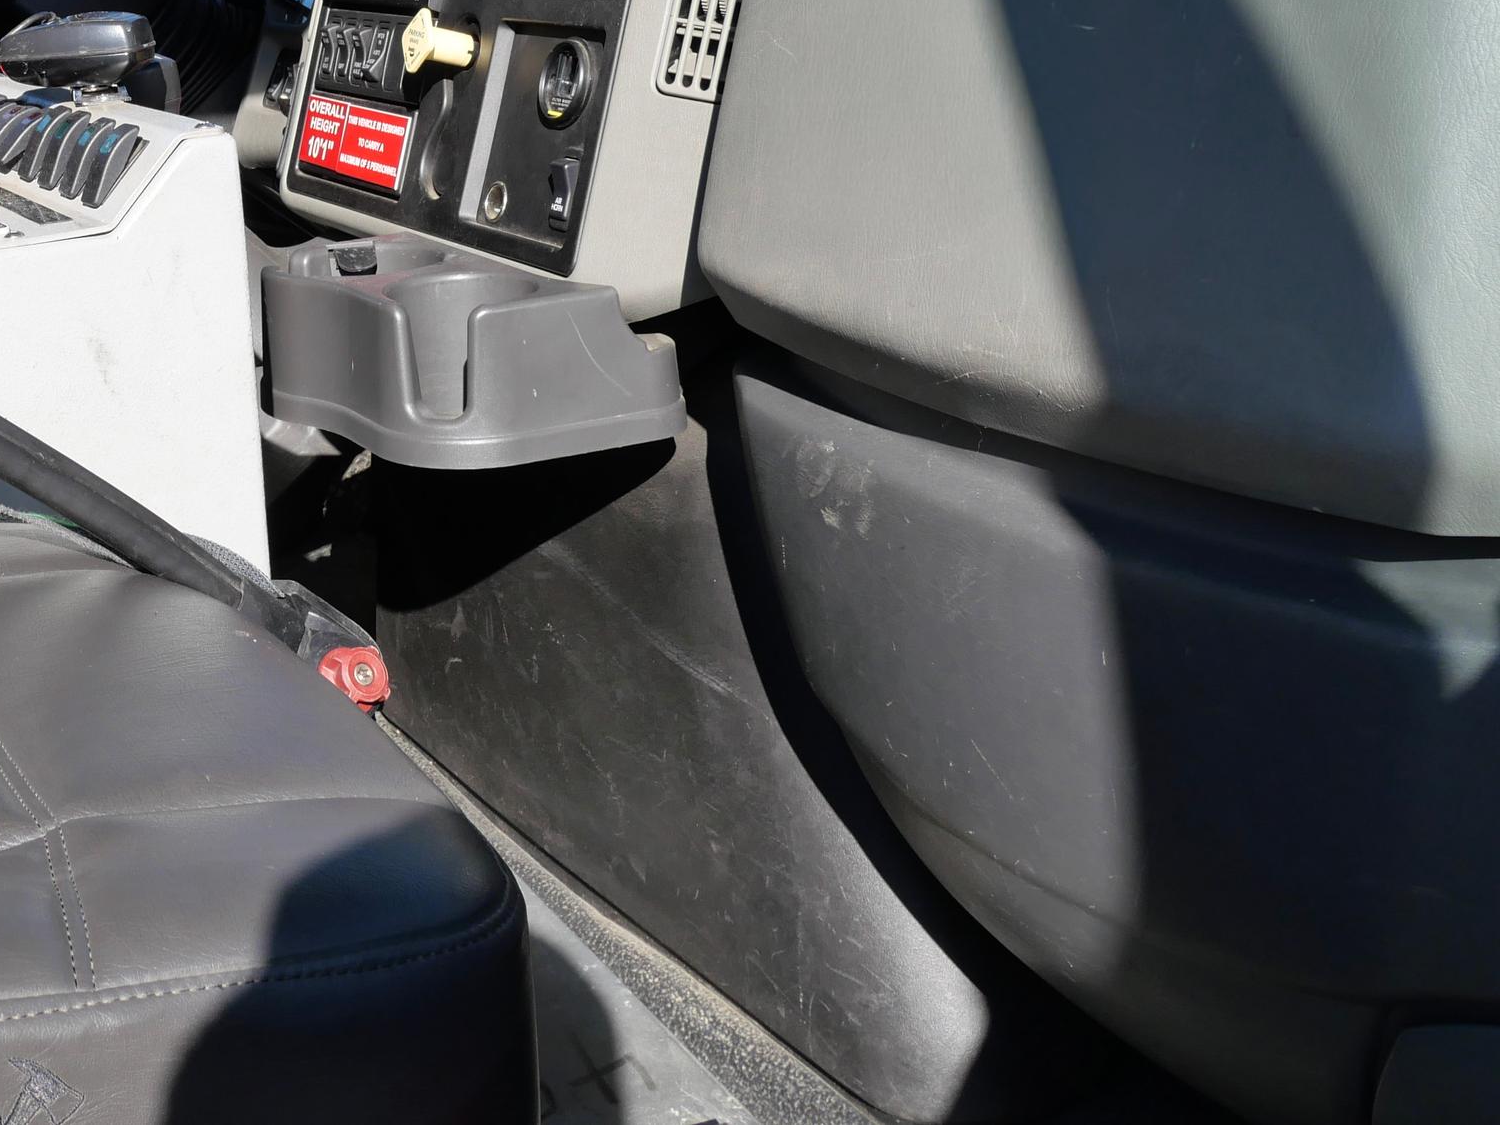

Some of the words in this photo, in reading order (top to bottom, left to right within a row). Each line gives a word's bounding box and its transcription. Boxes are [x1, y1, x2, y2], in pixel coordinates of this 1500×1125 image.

[309, 99, 345, 119] OVERALL
[310, 116, 340, 135] HEIGHT
[358, 117, 375, 130] VEHICLE
[375, 122, 381, 131] IS
[381, 123, 405, 136] DESIGNED
[308, 135, 334, 161] 10'1"
[358, 137, 364, 147] TO
[364, 139, 380, 151] CARRY
[379, 143, 384, 153] A
[339, 153, 360, 167] MAXIMUM
[360, 159, 367, 168] OF
[370, 162, 397, 177] PERSONNEL
[551, 203, 563, 212] HORN
